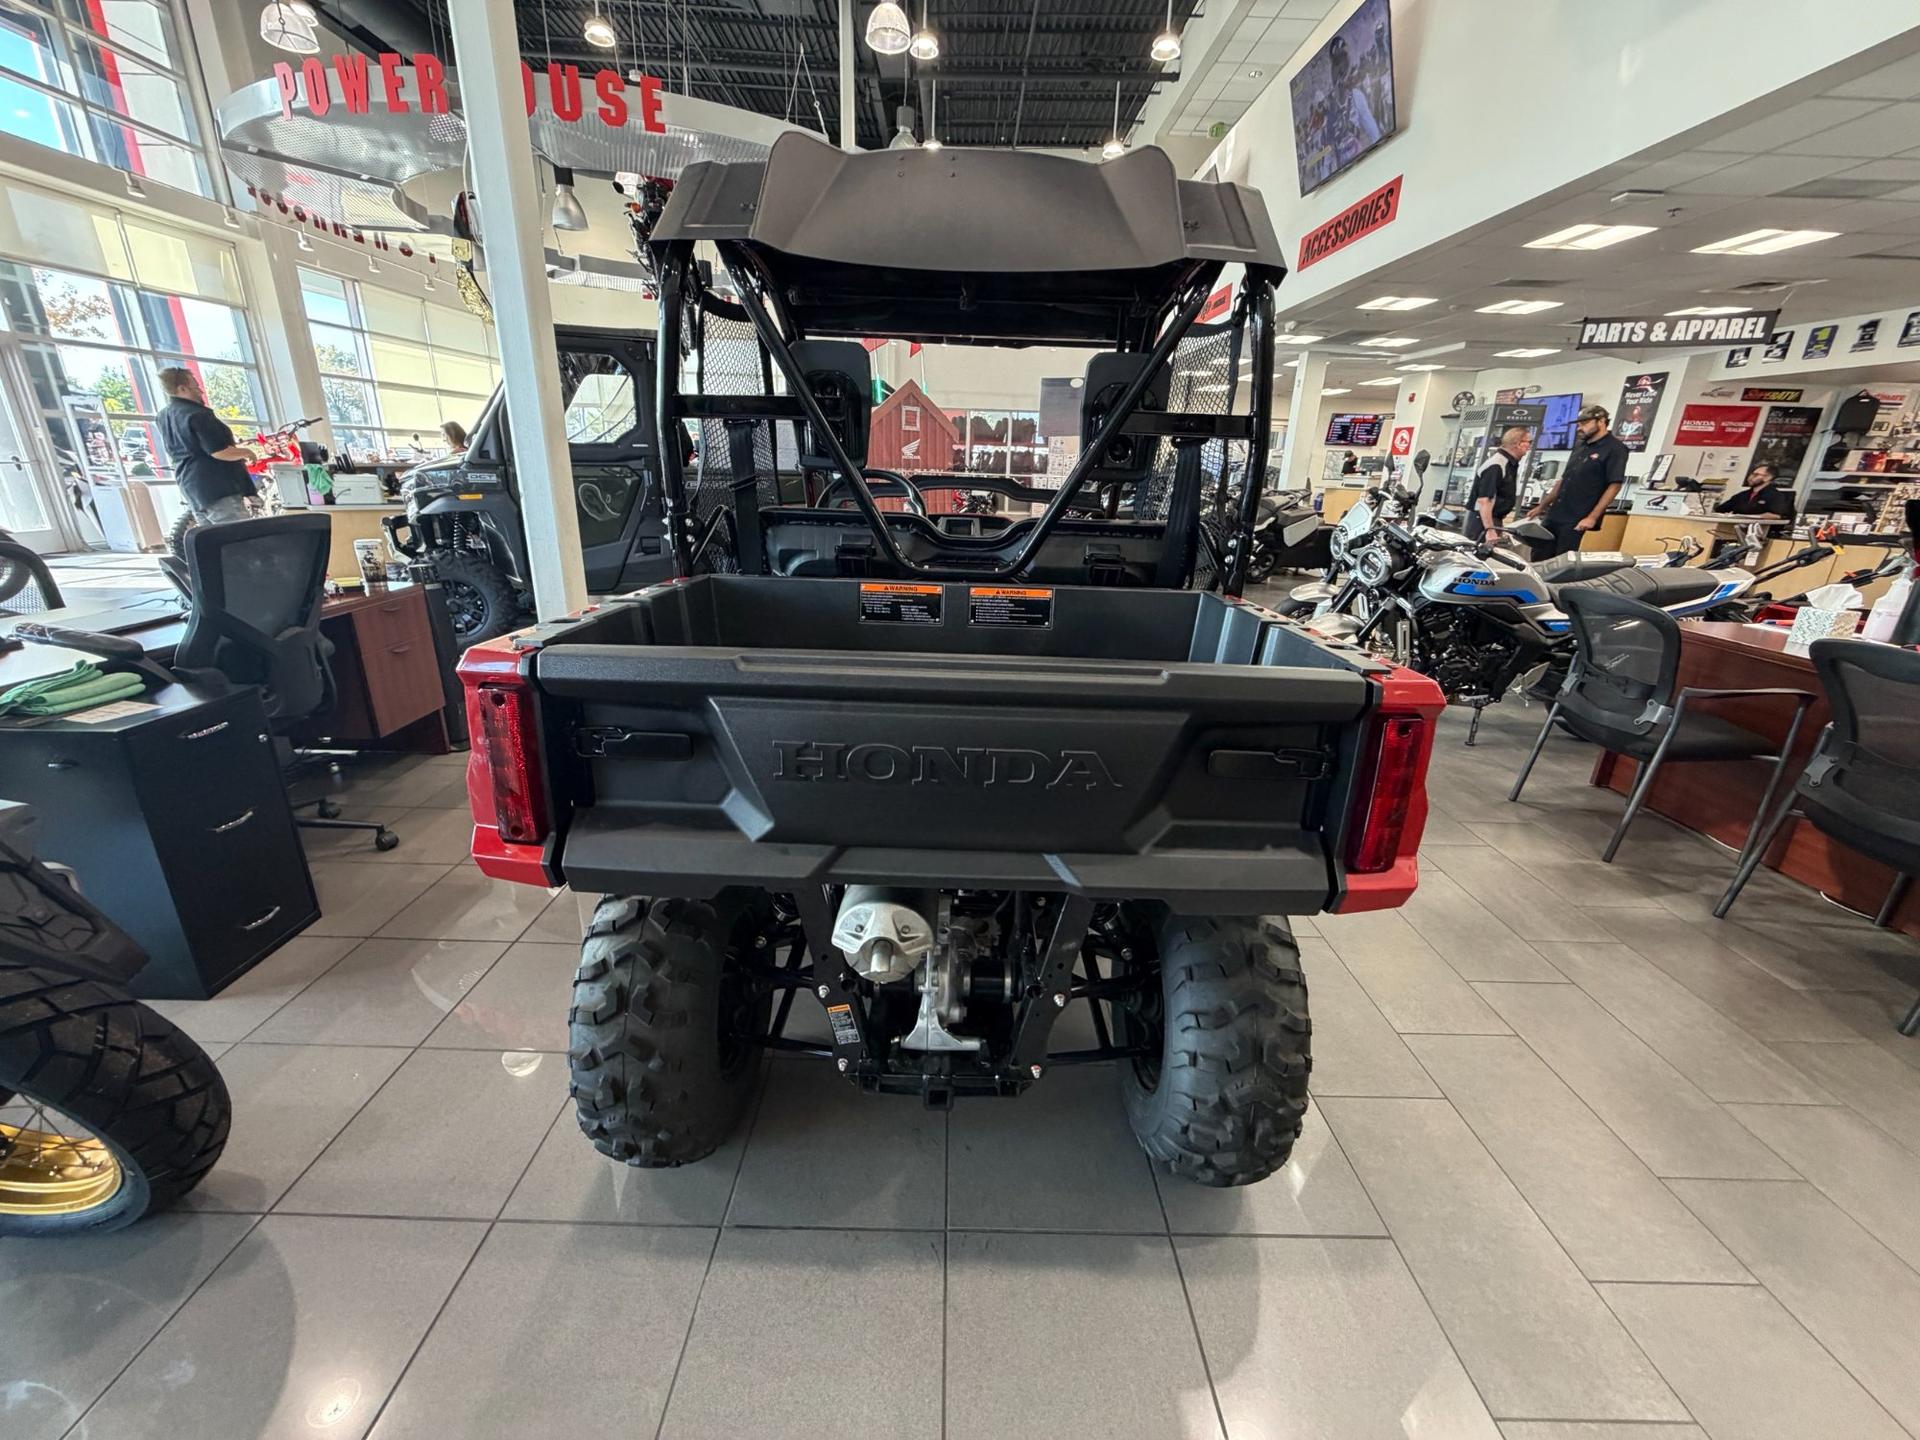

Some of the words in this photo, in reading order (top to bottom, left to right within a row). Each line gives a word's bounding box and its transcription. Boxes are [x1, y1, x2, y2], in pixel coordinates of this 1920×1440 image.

[1302, 187, 1395, 264] ACCESSORIES
[1582, 321, 1648, 344] PARTS
[1649, 321, 1668, 342] &
[1670, 316, 1767, 342] APPAREL
[1453, 576, 1496, 587] HONDA
[772, 739, 1124, 790] HONDA
